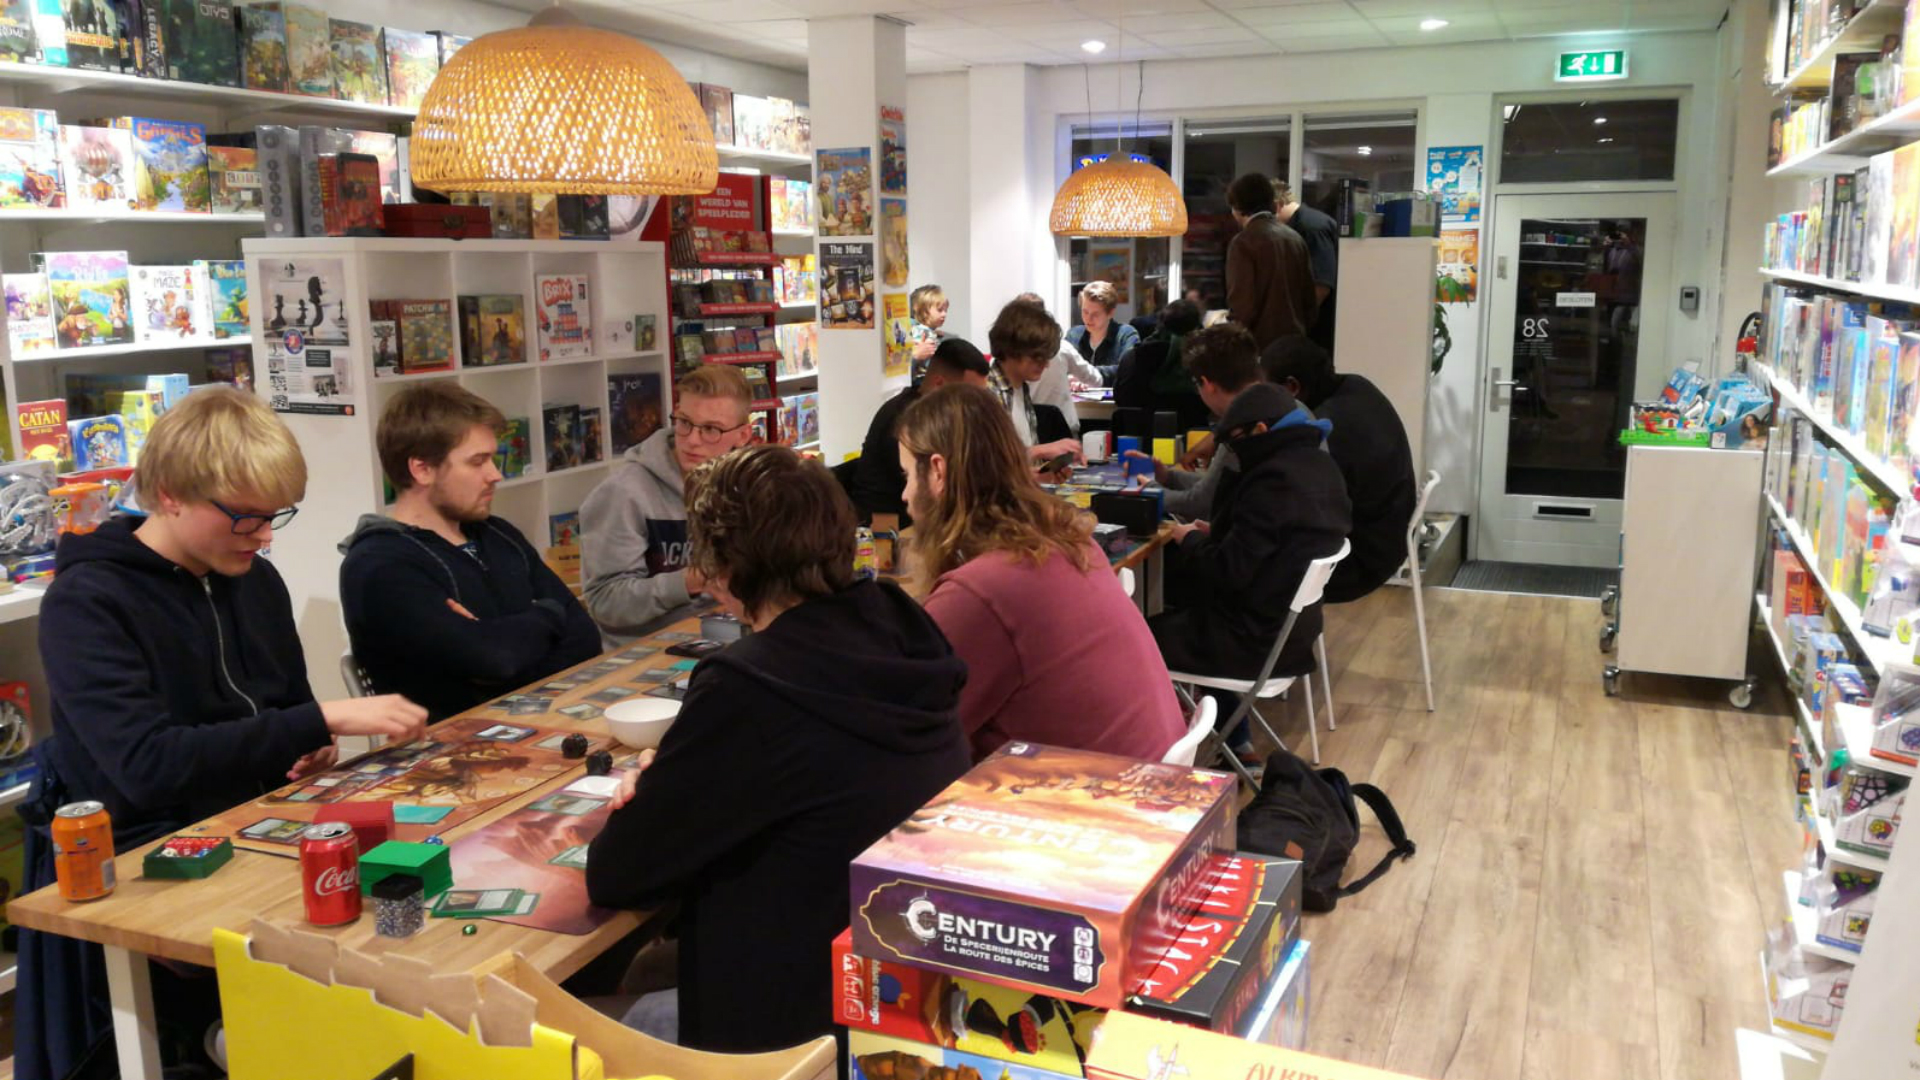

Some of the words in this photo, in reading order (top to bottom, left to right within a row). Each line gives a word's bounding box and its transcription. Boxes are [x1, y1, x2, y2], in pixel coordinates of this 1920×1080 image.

[153, 276, 181, 289] MAZE
[541, 279, 574, 305] BRIX
[19, 409, 61, 428] CATAN
[904, 898, 1057, 953] CENTURY
[944, 935, 959, 944] DE
[943, 943, 957, 953] LA
[958, 947, 991, 961] ROUTE
[993, 954, 1013, 966] DES
[1015, 958, 1050, 973] ÉPICES
